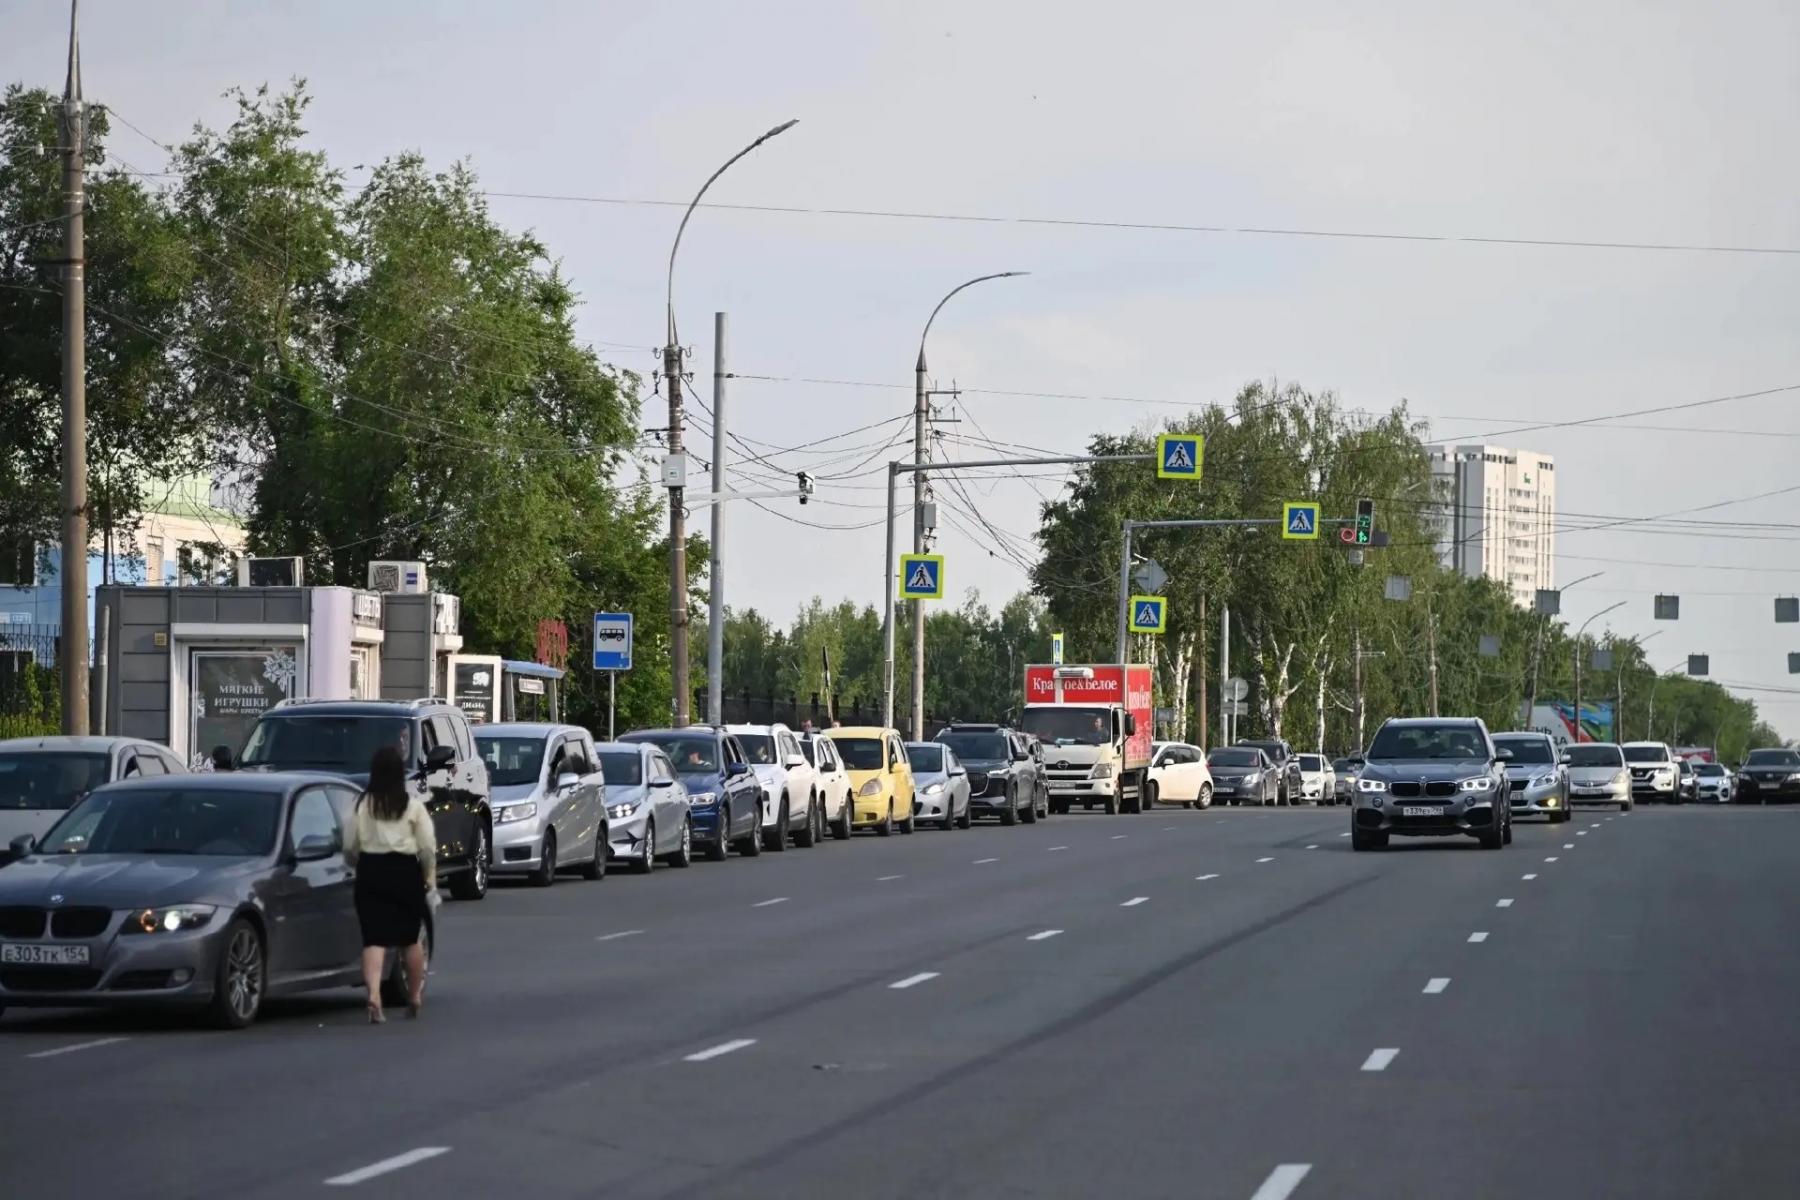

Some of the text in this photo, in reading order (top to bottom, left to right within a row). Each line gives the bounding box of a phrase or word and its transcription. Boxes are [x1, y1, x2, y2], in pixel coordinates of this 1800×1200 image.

[219, 685, 265, 695] МЯГКИЕ
[1033, 678, 1118, 694] Краое&Белое
[214, 697, 269, 707] ИГРУШКИ
[63, 946, 86, 960] 154
